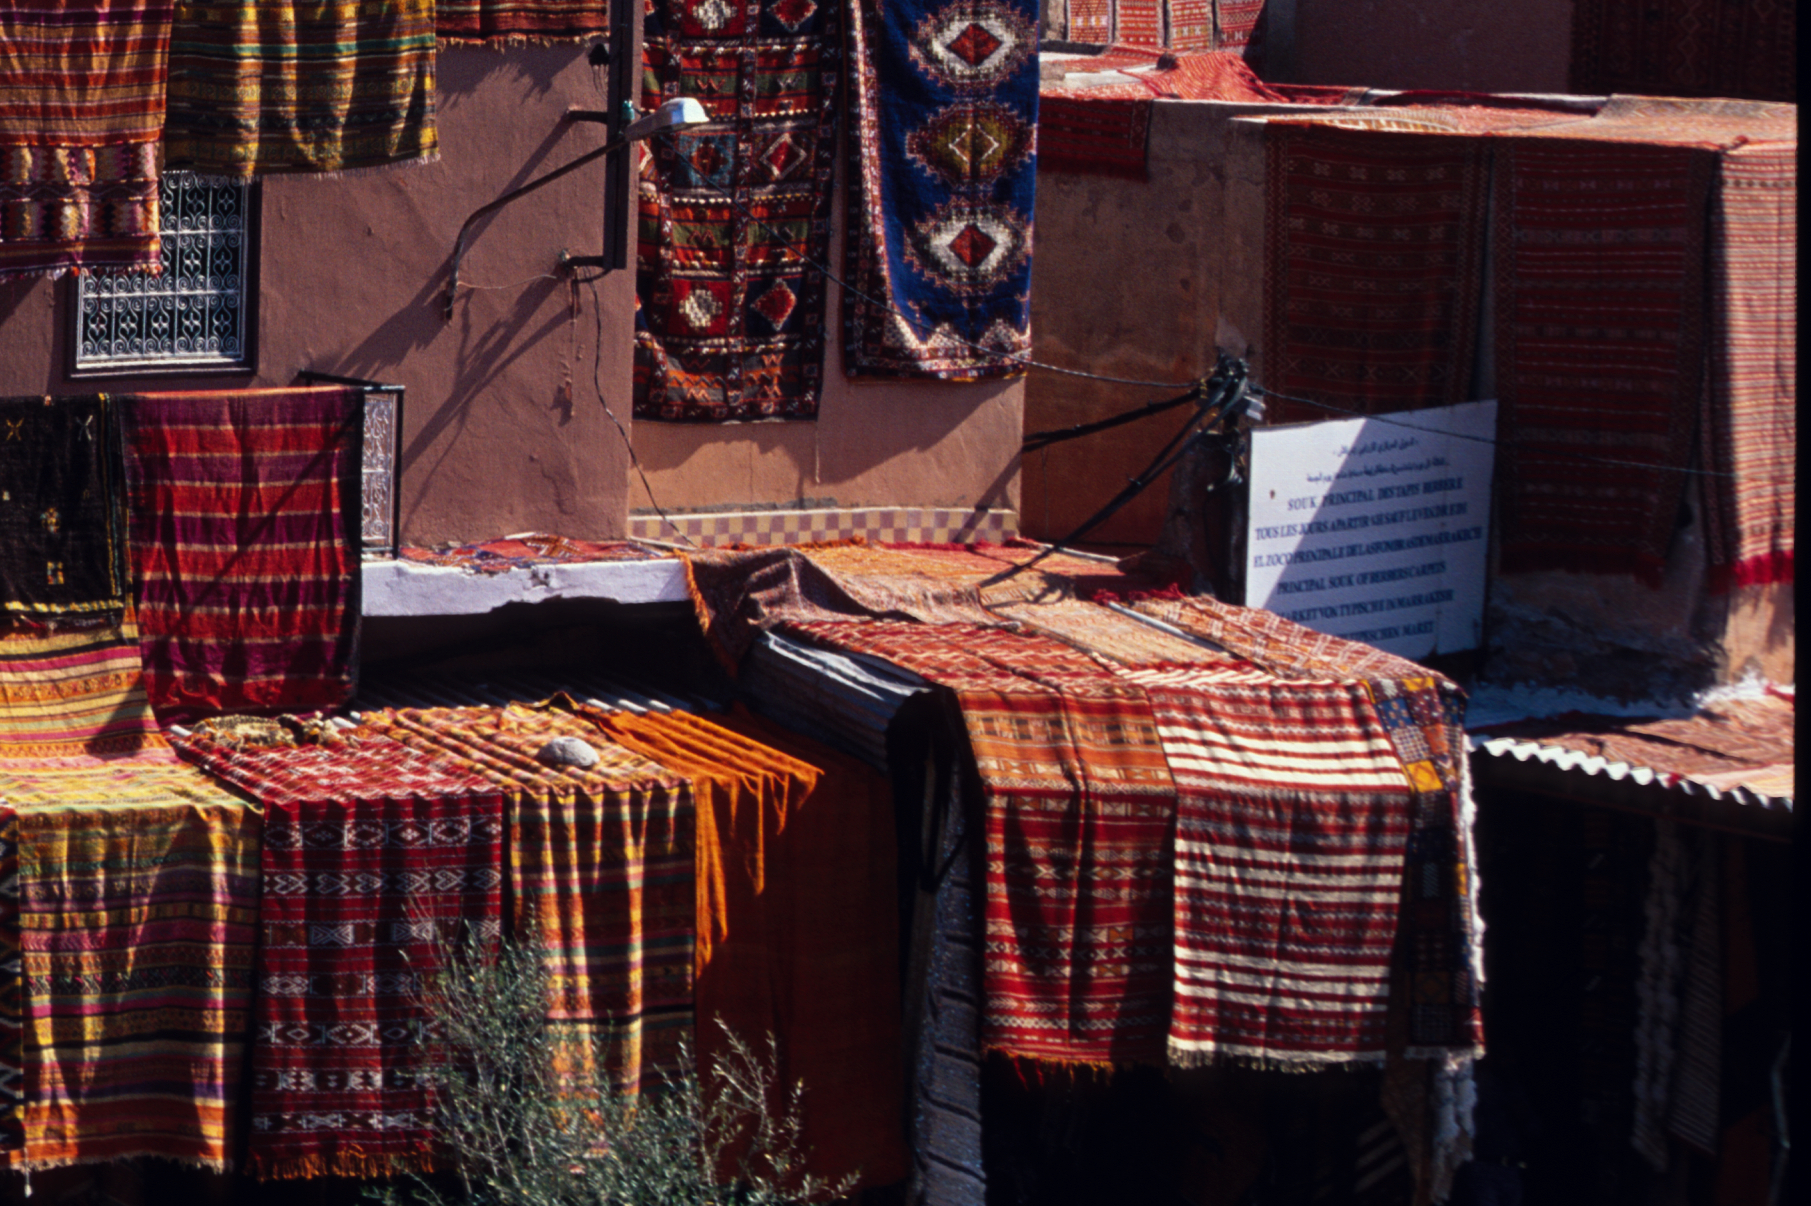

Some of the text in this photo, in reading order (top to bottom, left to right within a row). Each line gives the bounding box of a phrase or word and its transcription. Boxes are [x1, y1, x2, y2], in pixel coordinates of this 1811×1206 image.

[1288, 495, 1317, 511] SOUK
[1323, 488, 1374, 506] PRINCIPAL
[1255, 527, 1279, 541] TOUS
[1281, 525, 1298, 537] LES
[1299, 521, 1328, 535] JOURS
[1254, 556, 1263, 568] EL
[1266, 552, 1293, 566] ZOCO
[1278, 578, 1325, 594] PRINCIPAL
[1329, 574, 1354, 588] SOUK
